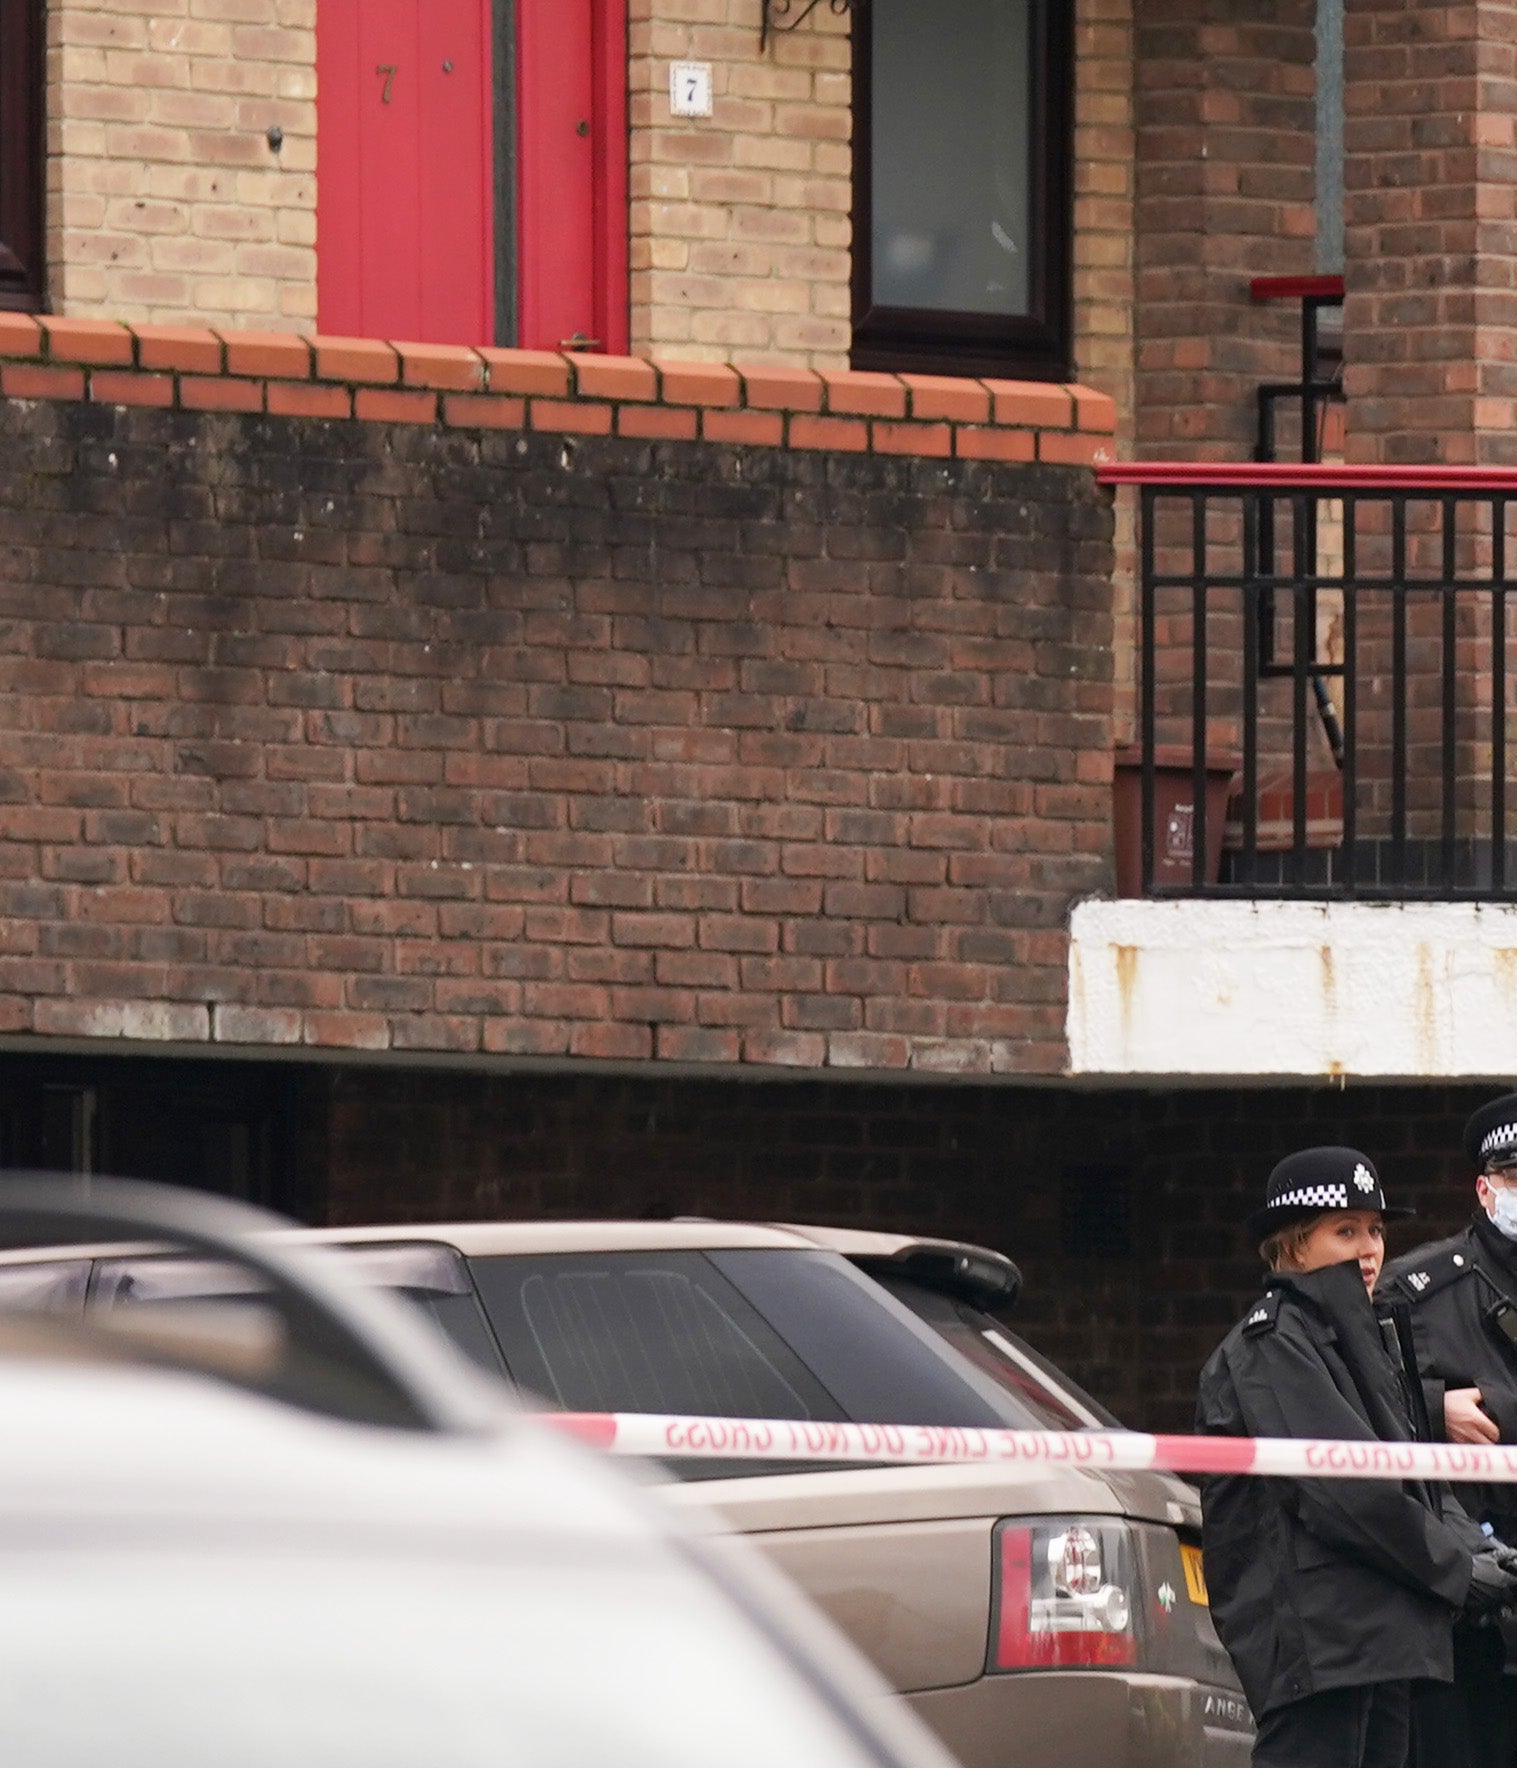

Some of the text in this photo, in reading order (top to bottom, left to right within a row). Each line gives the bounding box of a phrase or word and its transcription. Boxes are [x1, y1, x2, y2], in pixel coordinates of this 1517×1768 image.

[376, 63, 397, 106] 7
[686, 78, 697, 102] 7
[1201, 1695, 1244, 1722] ANGE
